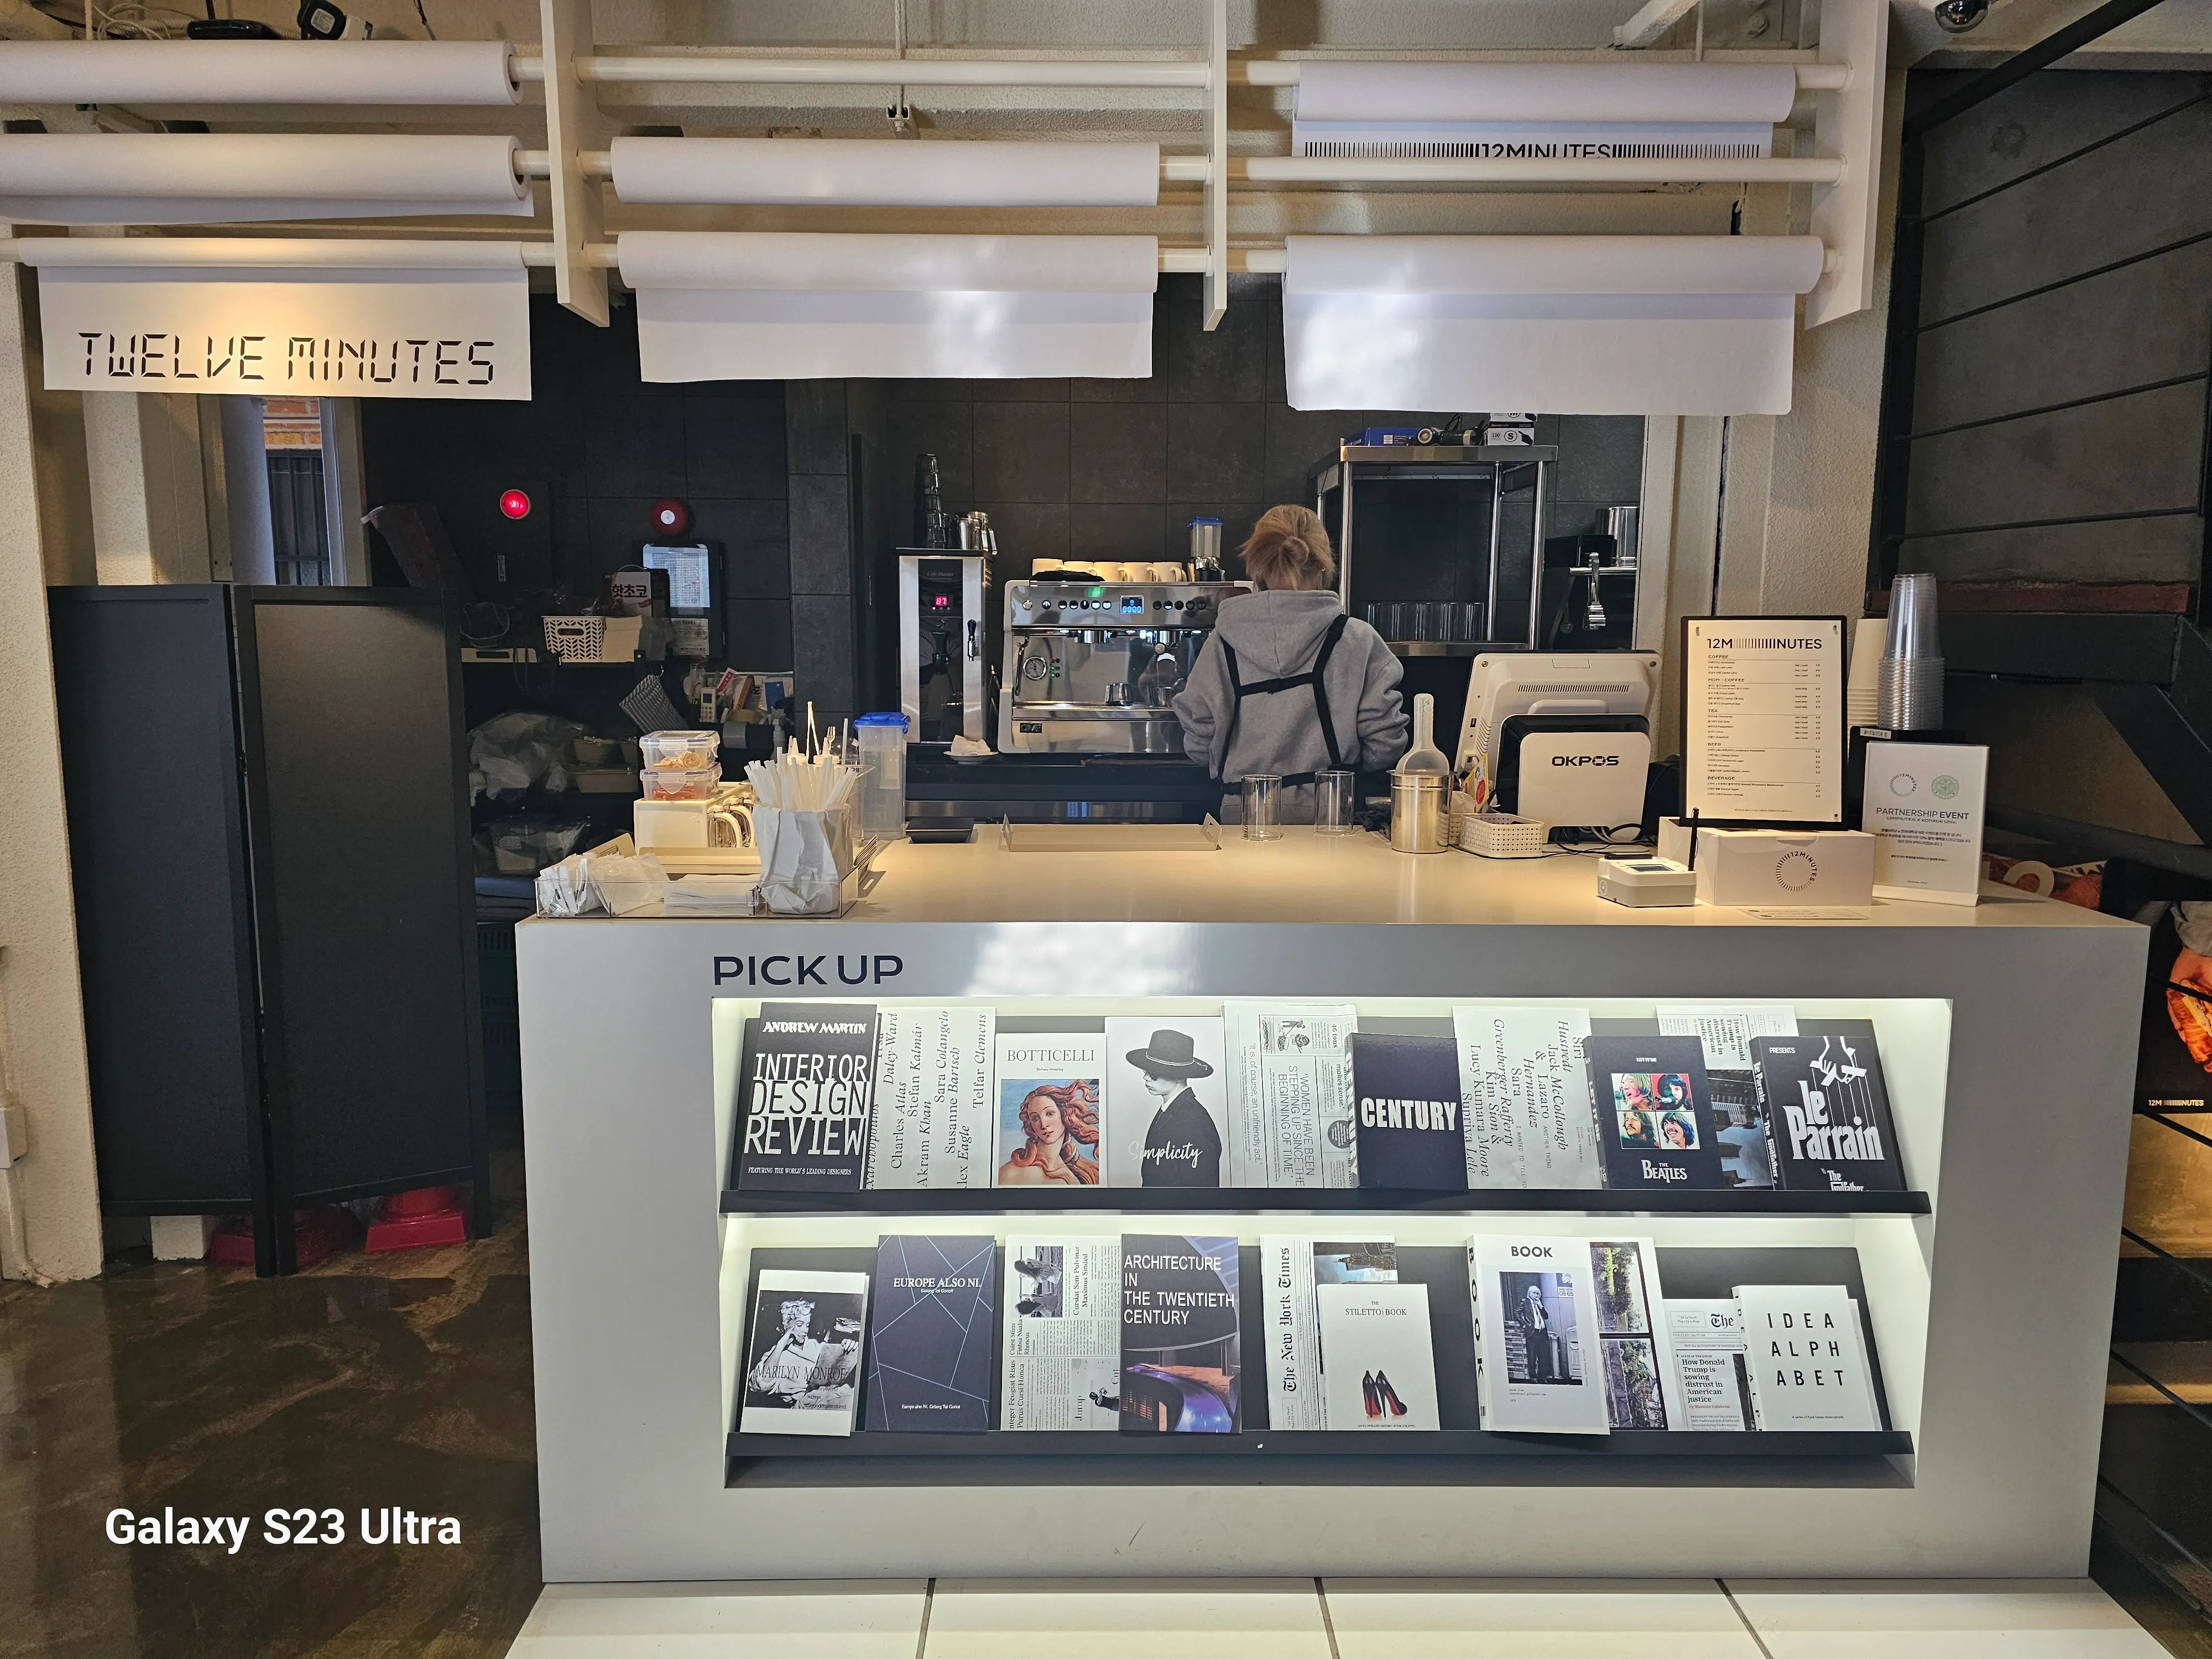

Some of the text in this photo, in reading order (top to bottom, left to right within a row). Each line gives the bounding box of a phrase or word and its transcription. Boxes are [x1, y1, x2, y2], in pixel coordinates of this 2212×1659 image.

[78, 332, 494, 385] TWELVE MINUTES
[612, 584, 648, 598] 핫초코
[1551, 755, 1620, 766] OKPOS
[1876, 807, 1969, 820] PARTNERSHIP EVENT
[713, 954, 904, 985] PICK UP
[762, 1021, 867, 1035] ANDREW MARTIN
[1332, 1024, 1337, 1032] 46
[883, 1013, 898, 1084] Daley-Ward
[934, 1011, 952, 1103] Sara Colangelo
[972, 1014, 987, 1108] Telfar Clemens
[1006, 1049, 1095, 1062] BOTTICELLI
[1558, 1020, 1573, 1073] Hustvedt
[1572, 1037, 1584, 1060] Siri
[753, 1053, 868, 1082] INTERIOR
[907, 1022, 922, 1117] Stefan Kalmár
[1494, 1019, 1514, 1146] Greenberger Rafferty
[1511, 1068, 1522, 1097] Sara
[1523, 1058, 1538, 1128] Hernandez
[1535, 1051, 1550, 1119] & Lazaro
[1547, 1044, 1569, 1150] Jack McCollough
[750, 1080, 867, 1116] DESIGN
[945, 1047, 960, 1154] Susanne Bartsch
[1279, 1073, 1290, 1129] BEGINNING
[1470, 1045, 1490, 1177] Lucy Kumara Moore
[1485, 1071, 1502, 1145] Kim Sion &
[1797, 1080, 1828, 1125] le
[890, 1081, 907, 1168] Charles Atlas
[1288, 1066, 1305, 1186] STEPPING UP SINCE THE
[1345, 1051, 1358, 1175] CENTURY
[1360, 1097, 1457, 1132] CENTURY
[1592, 1108, 1599, 1120] IT
[744, 1116, 862, 1156] REVIEW
[917, 1100, 931, 1187] Akram Khan
[1282, 1131, 1292, 1146] OF
[1303, 1119, 1313, 1145] HAVE
[1594, 1124, 1600, 1142] BE
[1782, 1105, 1885, 1160] Parrain
[957, 1125, 972, 1188] lex Eagle
[1128, 1140, 1203, 1169] Simplicity
[1305, 1148, 1314, 1176] BEEN
[1641, 1160, 1687, 1183] BEATLES
[1123, 1255, 1222, 1271] ARCHITECTURE
[1511, 1246, 1553, 1258] BOOK
[1124, 1273, 1138, 1287] IN
[1278, 1247, 1291, 1288] Times
[893, 1278, 935, 1287] EUROPE
[938, 1278, 966, 1287] ALSO
[1123, 1291, 1235, 1308] THE TWENTIETH
[1279, 1295, 1293, 1326] York
[1344, 1308, 1381, 1316] STILETTO
[1469, 1247, 1484, 1378] BOOK
[1123, 1310, 1190, 1326] CENTURY
[1710, 1312, 1734, 1329] The
[1767, 1312, 1834, 1329] IDEA
[1281, 1333, 1295, 1361] New
[1771, 1341, 1840, 1358] ALPH
[757, 1364, 847, 1381] MARILYN MONROE
[1282, 1366, 1297, 1392] The
[1776, 1370, 1844, 1387] ABET
[1009, 1380, 1017, 1406] Feugiat
[1074, 1395, 1086, 1421] Jump
